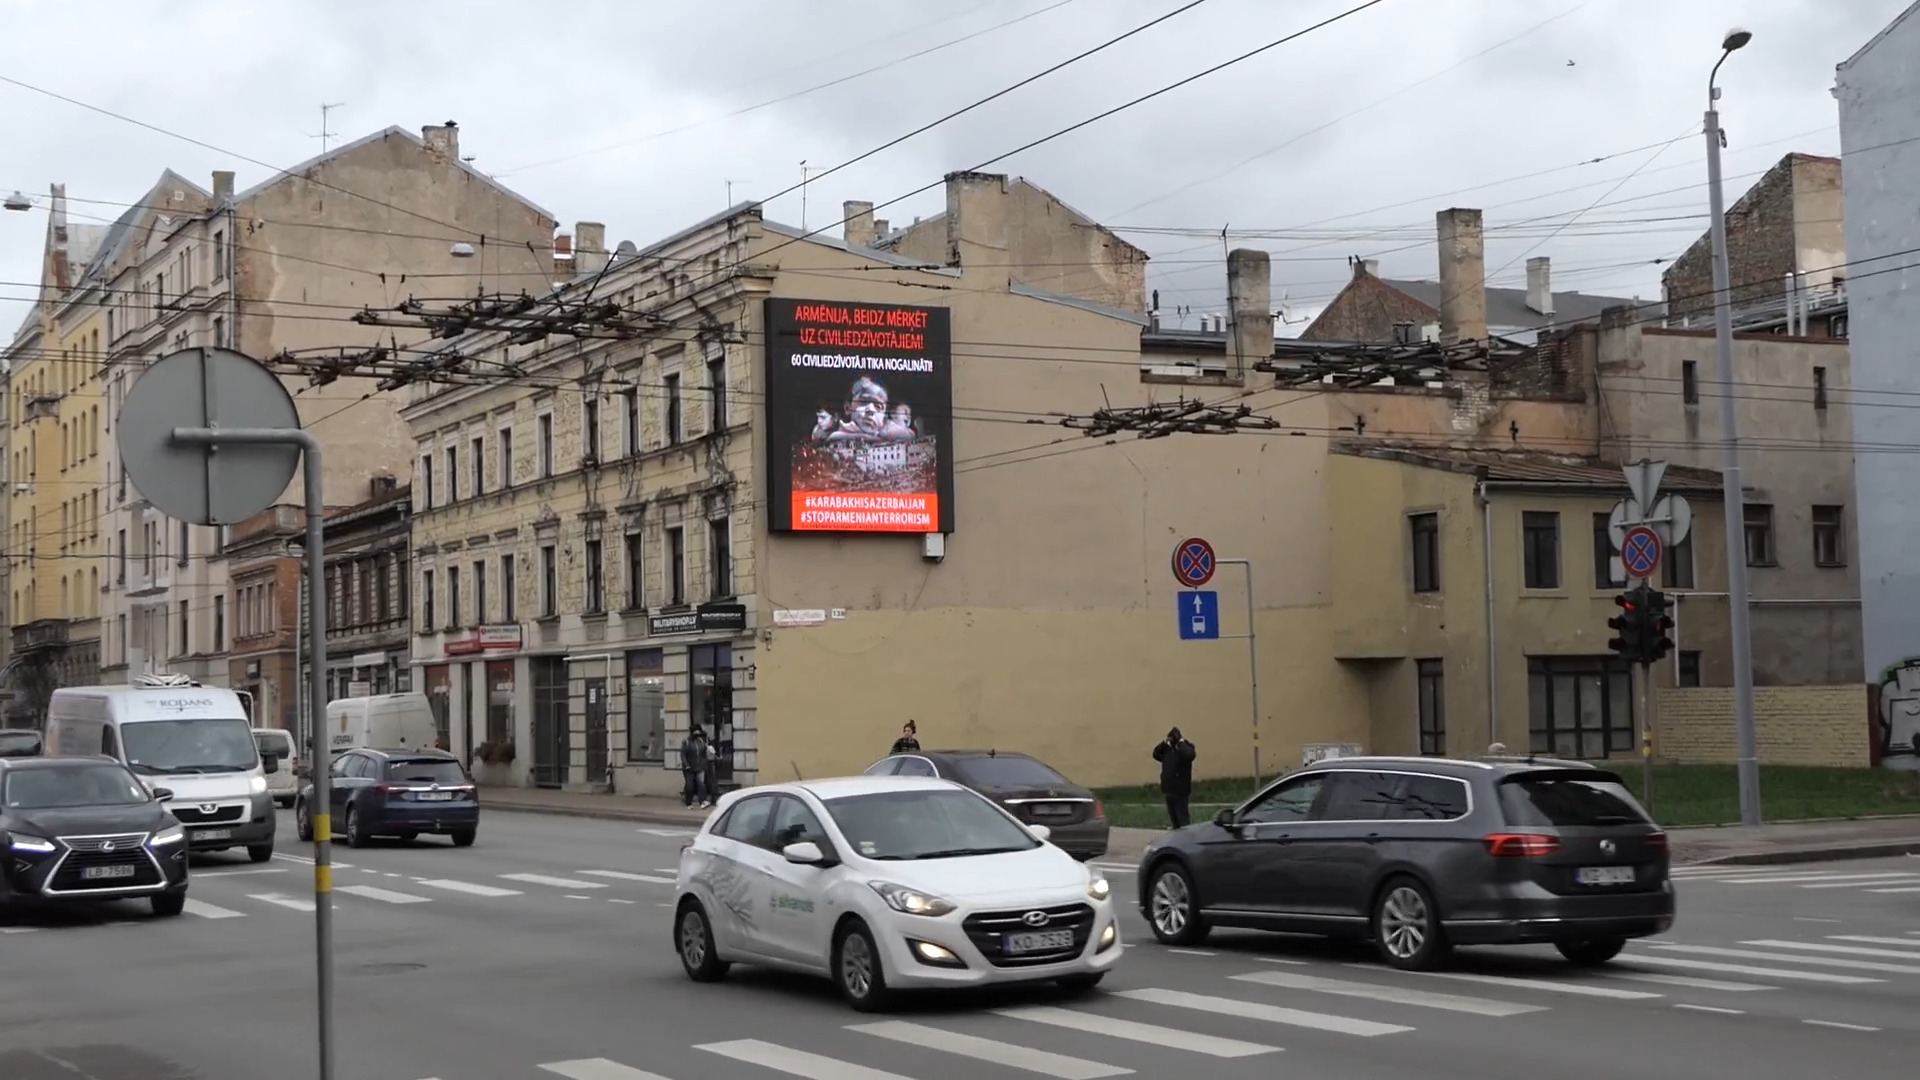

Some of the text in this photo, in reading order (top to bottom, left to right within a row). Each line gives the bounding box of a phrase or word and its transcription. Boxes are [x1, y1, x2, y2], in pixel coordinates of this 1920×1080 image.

[795, 304, 852, 326] ARMĒNIJA,
[854, 308, 885, 325] BEIDZ
[800, 328, 924, 349] UZ CIVILIEDZĪVOTĀJIEM!
[791, 354, 801, 366] 60
[867, 357, 885, 370] TIKA
[806, 496, 925, 509] #KARABAKHISAZERBAIJAN
[801, 511, 930, 525] #STOPARMENIANTERRORISM
